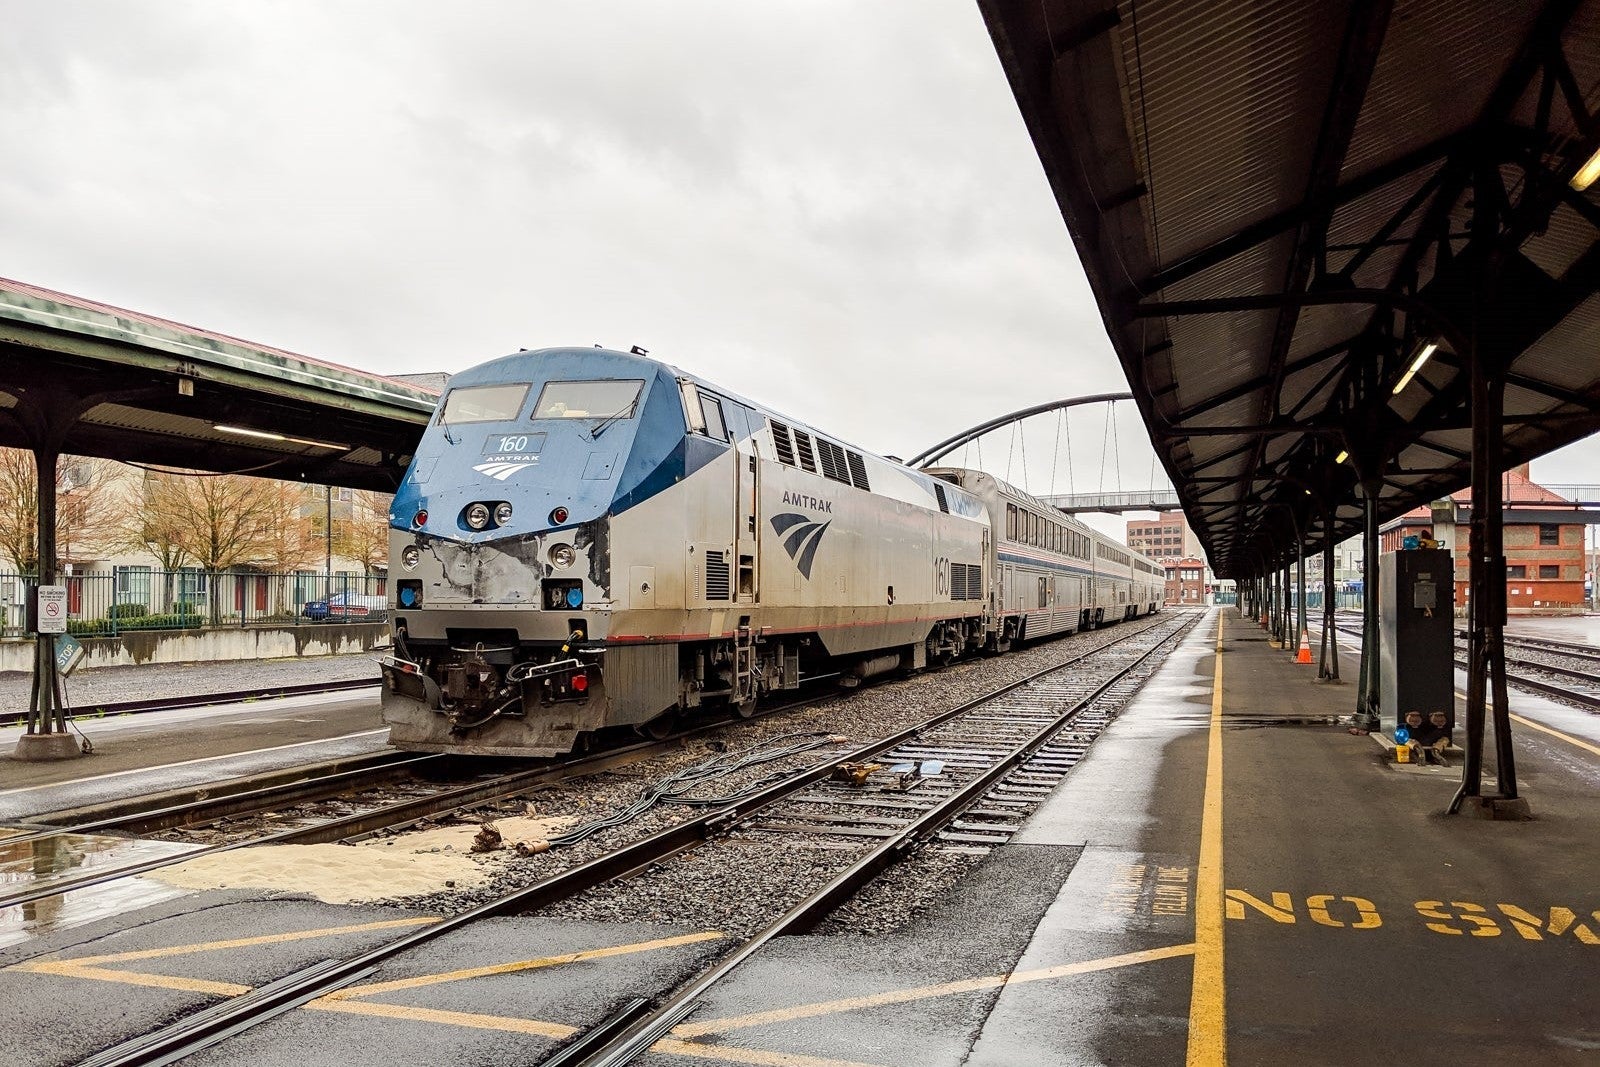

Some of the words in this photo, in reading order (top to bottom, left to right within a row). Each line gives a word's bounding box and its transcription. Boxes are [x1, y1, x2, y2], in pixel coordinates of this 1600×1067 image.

[498, 436, 528, 452] 160
[782, 490, 832, 514] AMTRAK
[934, 556, 950, 596] 160
[56, 644, 74, 666] STOP
[1158, 866, 1189, 883] LINE
[1152, 884, 1188, 915] YELLOW
[1225, 889, 1383, 929] NO
